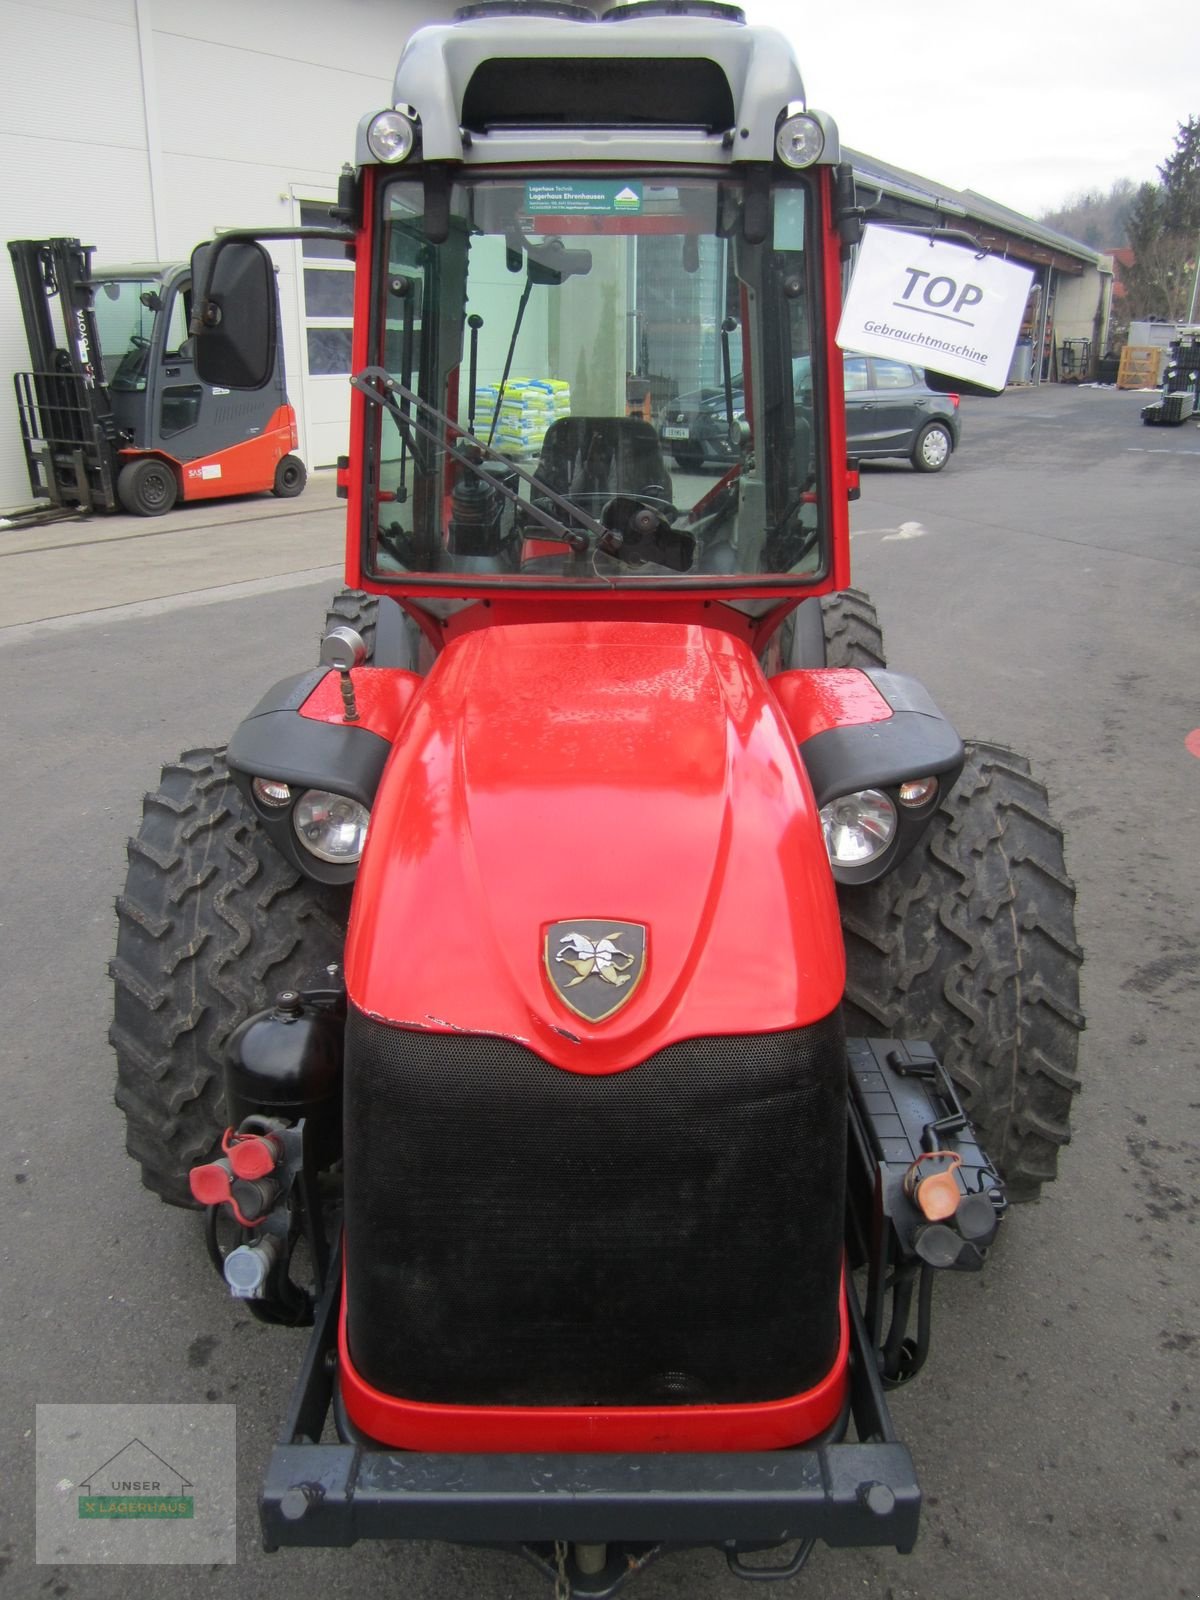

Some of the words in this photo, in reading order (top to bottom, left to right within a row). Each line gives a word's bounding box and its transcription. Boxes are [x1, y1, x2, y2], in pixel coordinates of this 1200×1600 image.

[529, 193, 562, 201] Lagerhaus
[901, 267, 983, 313] TOP
[864, 320, 989, 363] Gebrauchtmaschine
